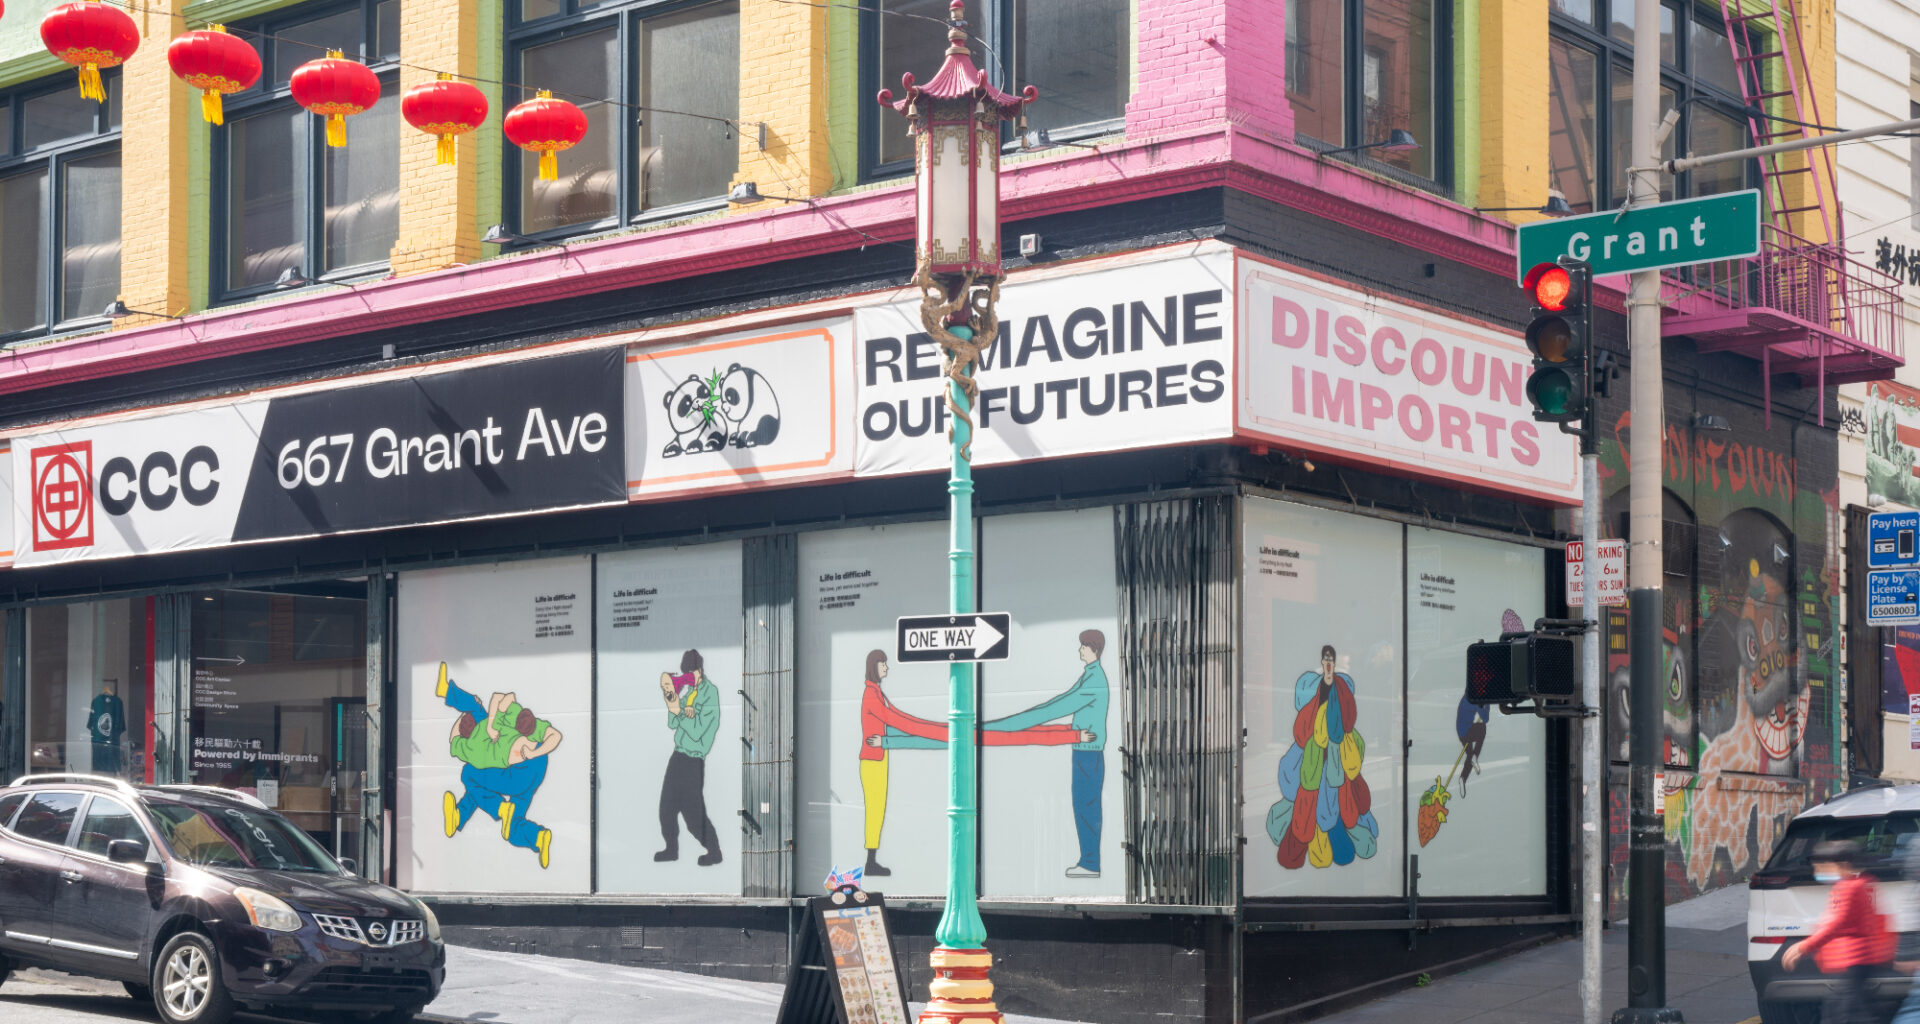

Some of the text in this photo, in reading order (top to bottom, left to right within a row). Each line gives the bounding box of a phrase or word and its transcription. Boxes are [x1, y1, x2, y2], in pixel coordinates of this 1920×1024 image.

[1567, 215, 1706, 263] Grant
[865, 288, 1223, 387] REMAGINE
[1271, 295, 1534, 407] DISCOUN
[979, 359, 1225, 429] FUTURES
[1291, 365, 1541, 466] IMPORTS
[277, 407, 608, 490] 667 Grant Ave
[1615, 411, 1797, 504] CNATOWN
[99, 445, 220, 516] CCC
[1872, 517, 1917, 530] Pay here
[1568, 544, 1622, 560] NO RKING
[819, 569, 871, 582] Life is difficult
[1871, 574, 1905, 586] Pay by
[613, 589, 625, 598] Life
[1871, 585, 1908, 594] License
[1871, 595, 1896, 604] Plate
[1872, 606, 1916, 616] 65008003
[909, 629, 975, 648] ONE WAY
[194, 749, 318, 763] Powered by Immigrants
